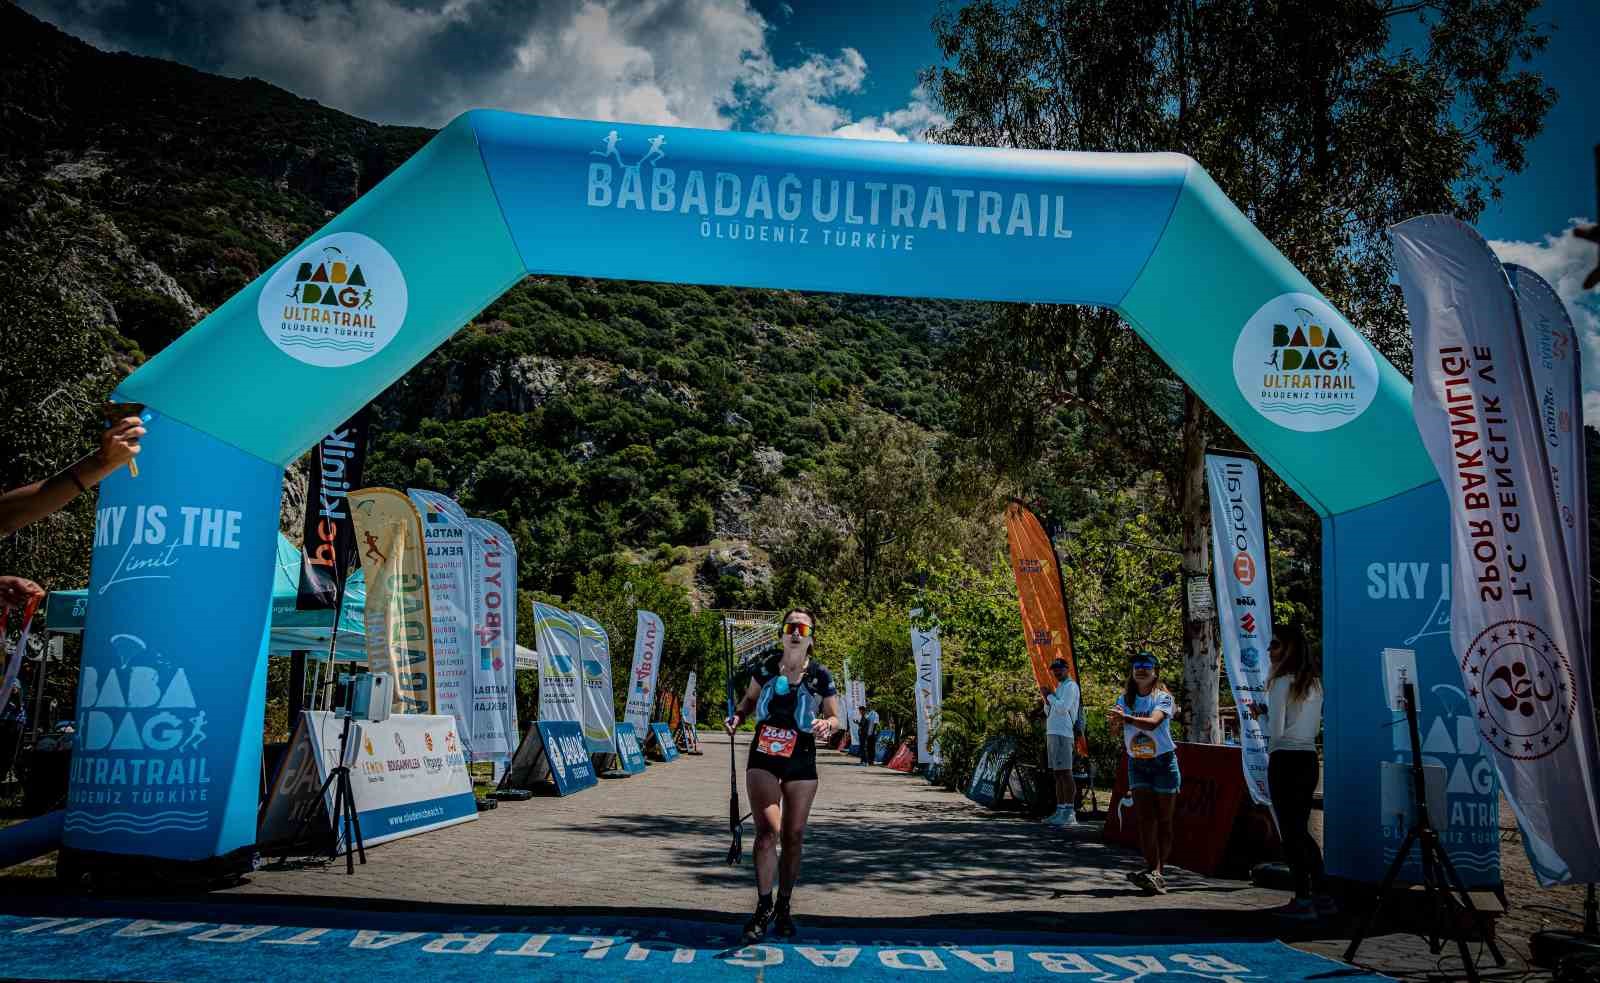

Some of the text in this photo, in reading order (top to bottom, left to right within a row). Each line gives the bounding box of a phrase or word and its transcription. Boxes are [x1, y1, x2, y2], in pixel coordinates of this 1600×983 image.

[296, 262, 367, 287] BABA
[283, 305, 376, 329] ULTRATRAIL
[1272, 324, 1342, 348] BABA
[1264, 374, 1356, 390] ULTRATRAIL
[94, 505, 242, 549] KY IS THE
[99, 537, 179, 594] Limit
[1367, 562, 1451, 600] SKY I
[81, 666, 196, 708] BABA
